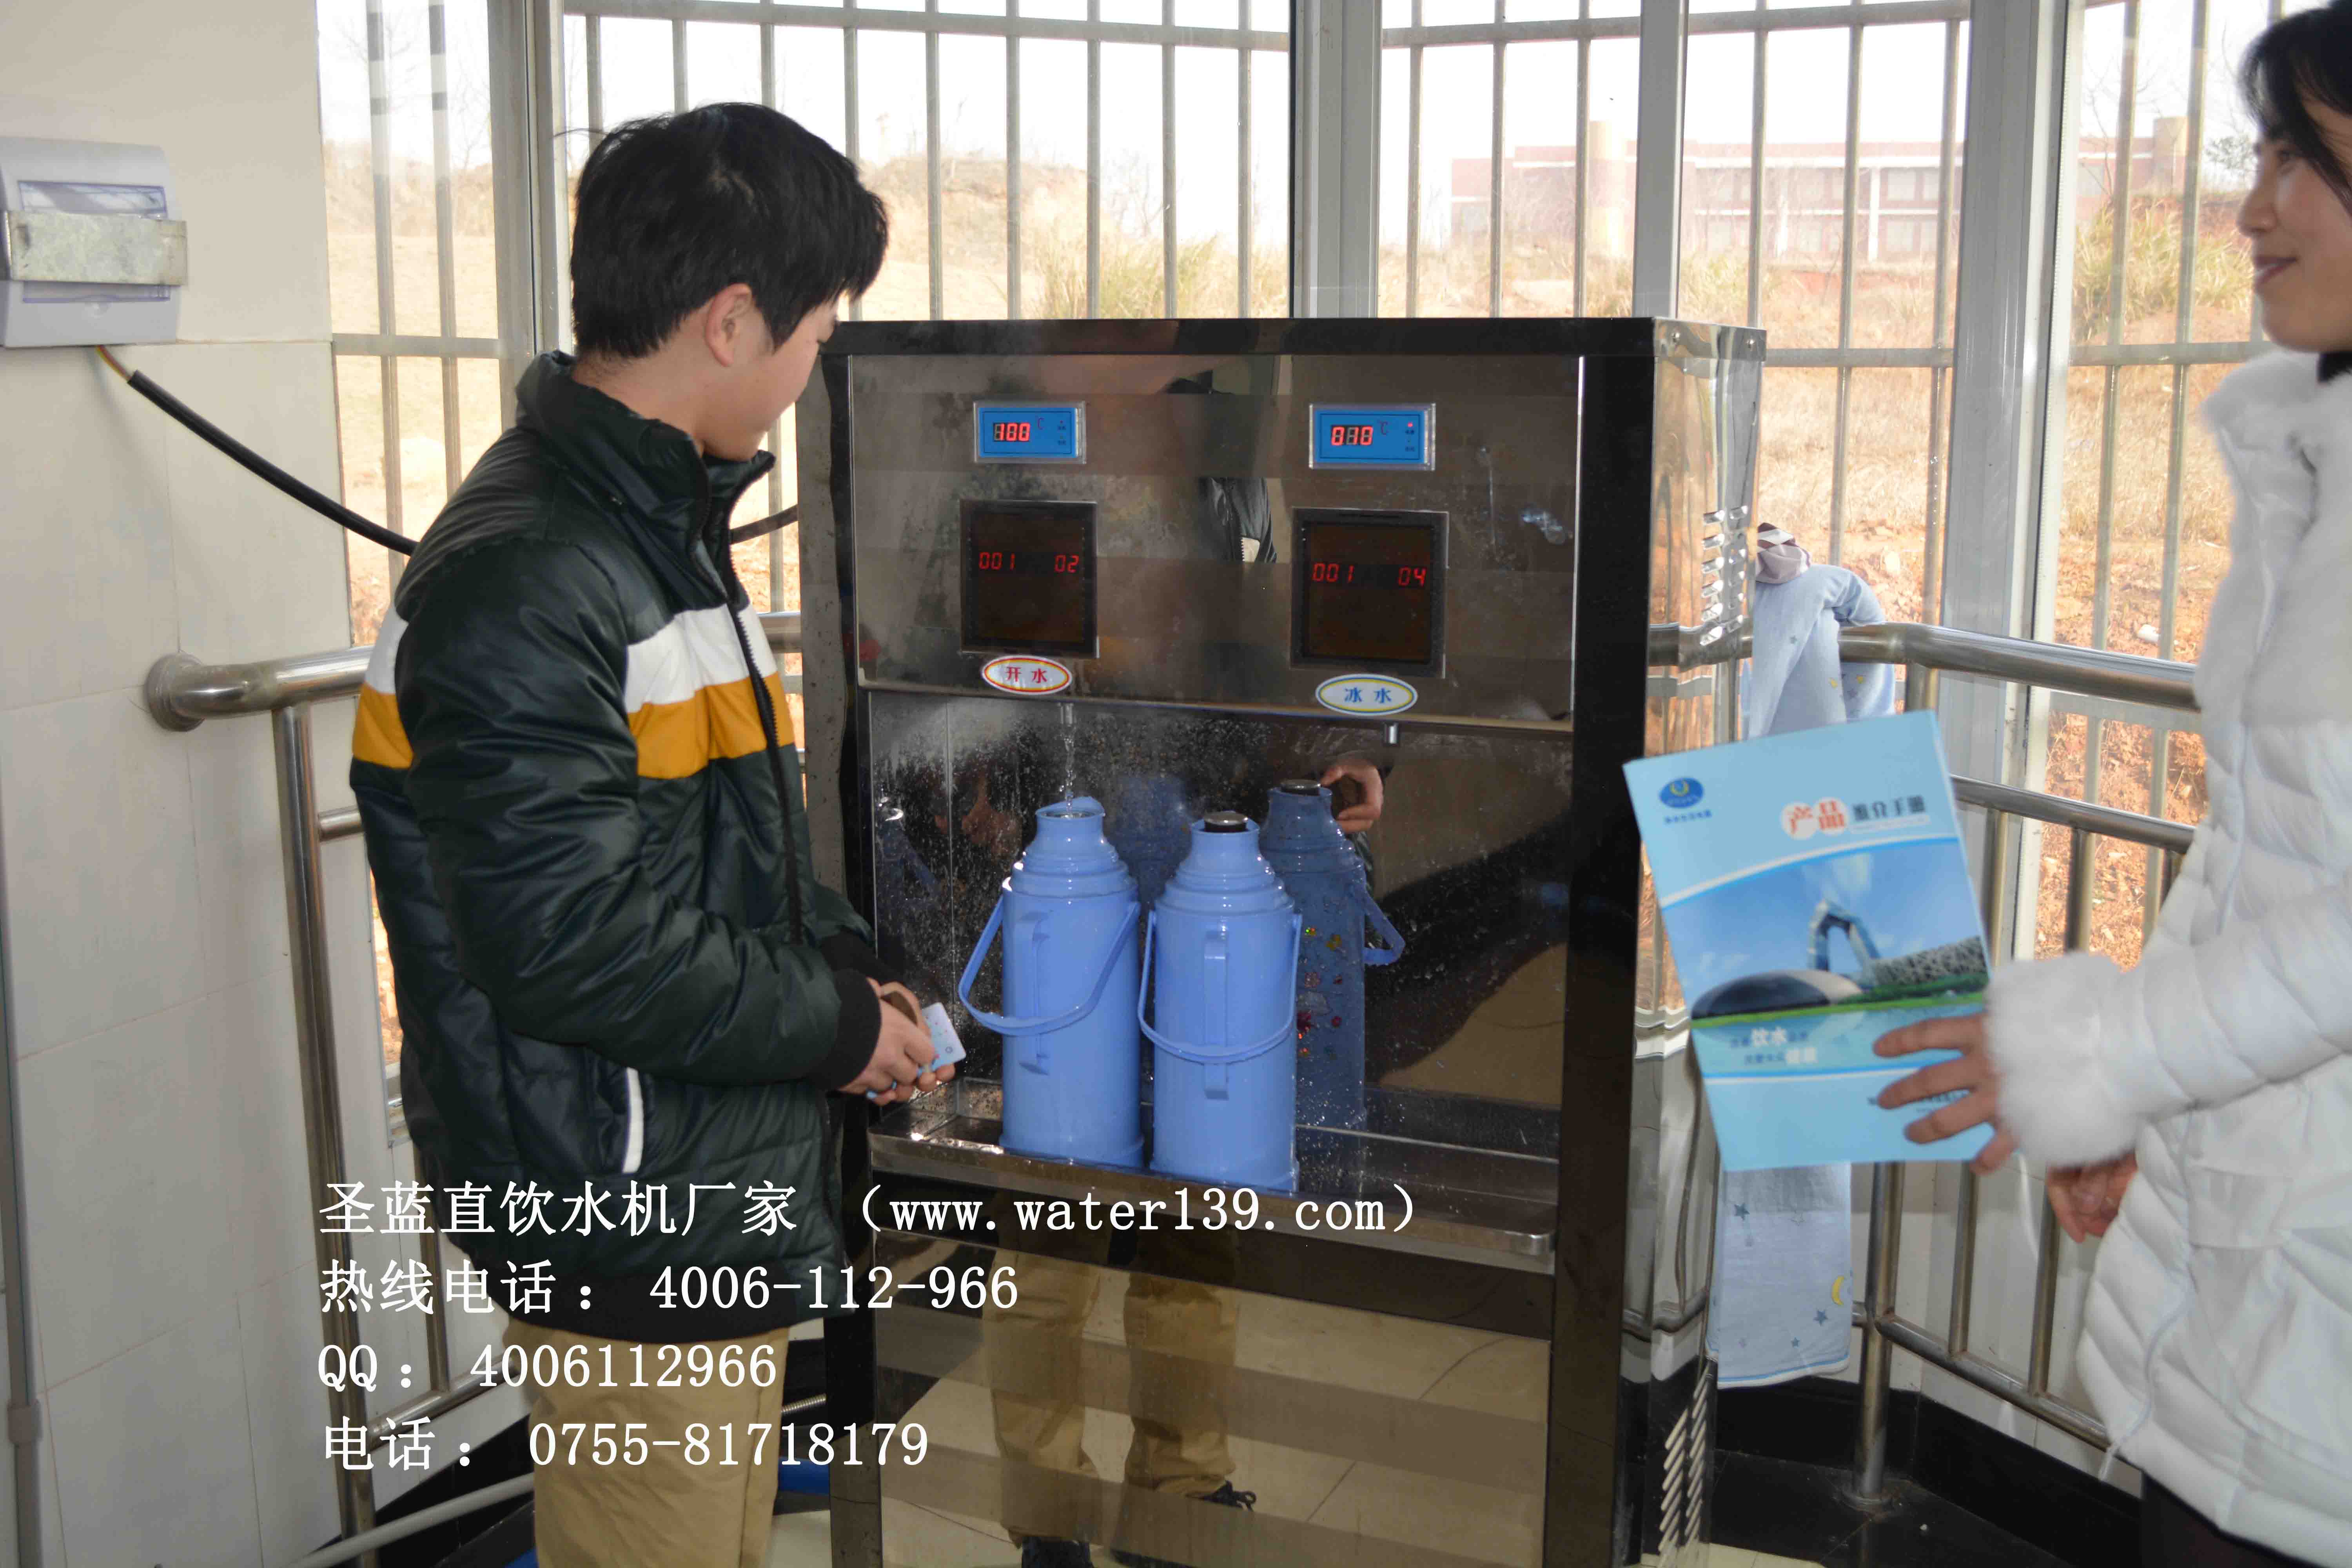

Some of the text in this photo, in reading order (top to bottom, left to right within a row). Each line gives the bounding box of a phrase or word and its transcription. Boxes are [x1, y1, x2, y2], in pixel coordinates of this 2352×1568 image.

[999, 422, 1031, 442] 100
[1331, 426, 1374, 446] 010
[978, 552, 1079, 573] 001 02
[1312, 563, 1426, 587] 001 04
[1005, 666, 1048, 684] 开水
[1344, 686, 1391, 704] 冰水
